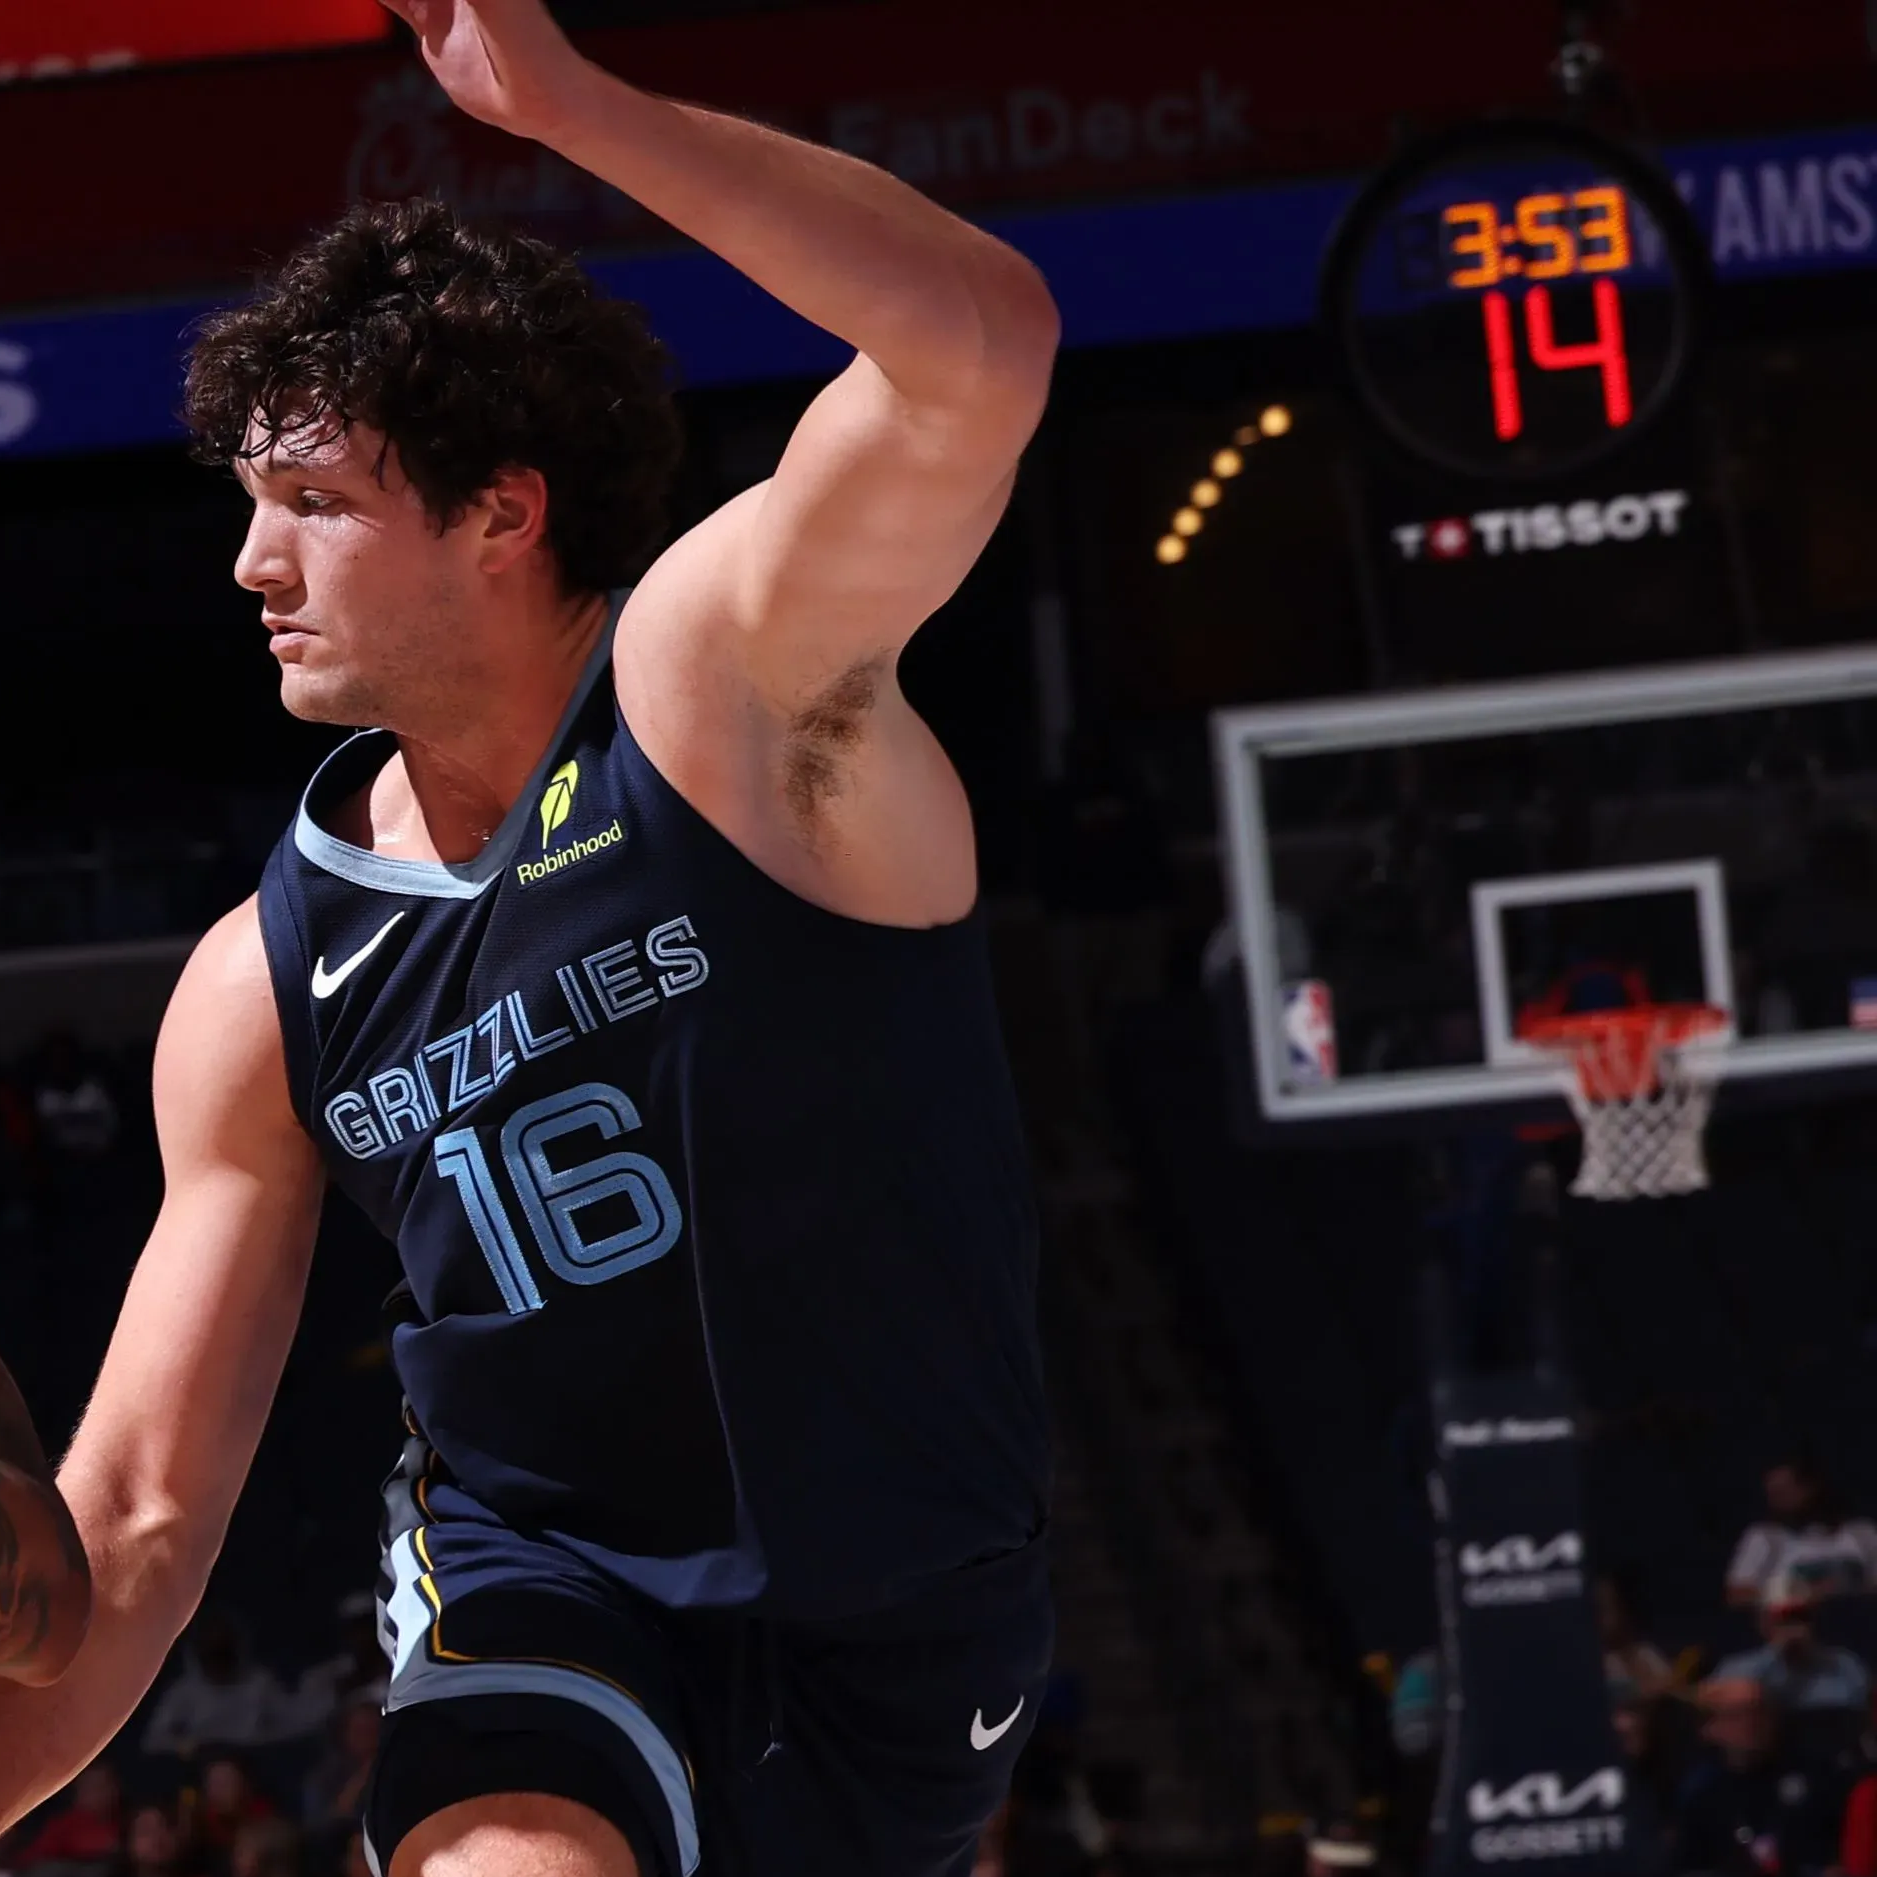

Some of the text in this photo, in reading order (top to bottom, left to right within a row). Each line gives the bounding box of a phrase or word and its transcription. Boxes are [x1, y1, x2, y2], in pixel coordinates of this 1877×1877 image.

[1442, 185, 1634, 290] 3:53
[1711, 150, 1877, 266] AMS
[1481, 276, 1635, 441] 14
[1471, 488, 1691, 558] TISSOT
[517, 818, 622, 885] Robinhood
[324, 915, 711, 1161] GRIZZLIES
[433, 1081, 684, 1317] 16
